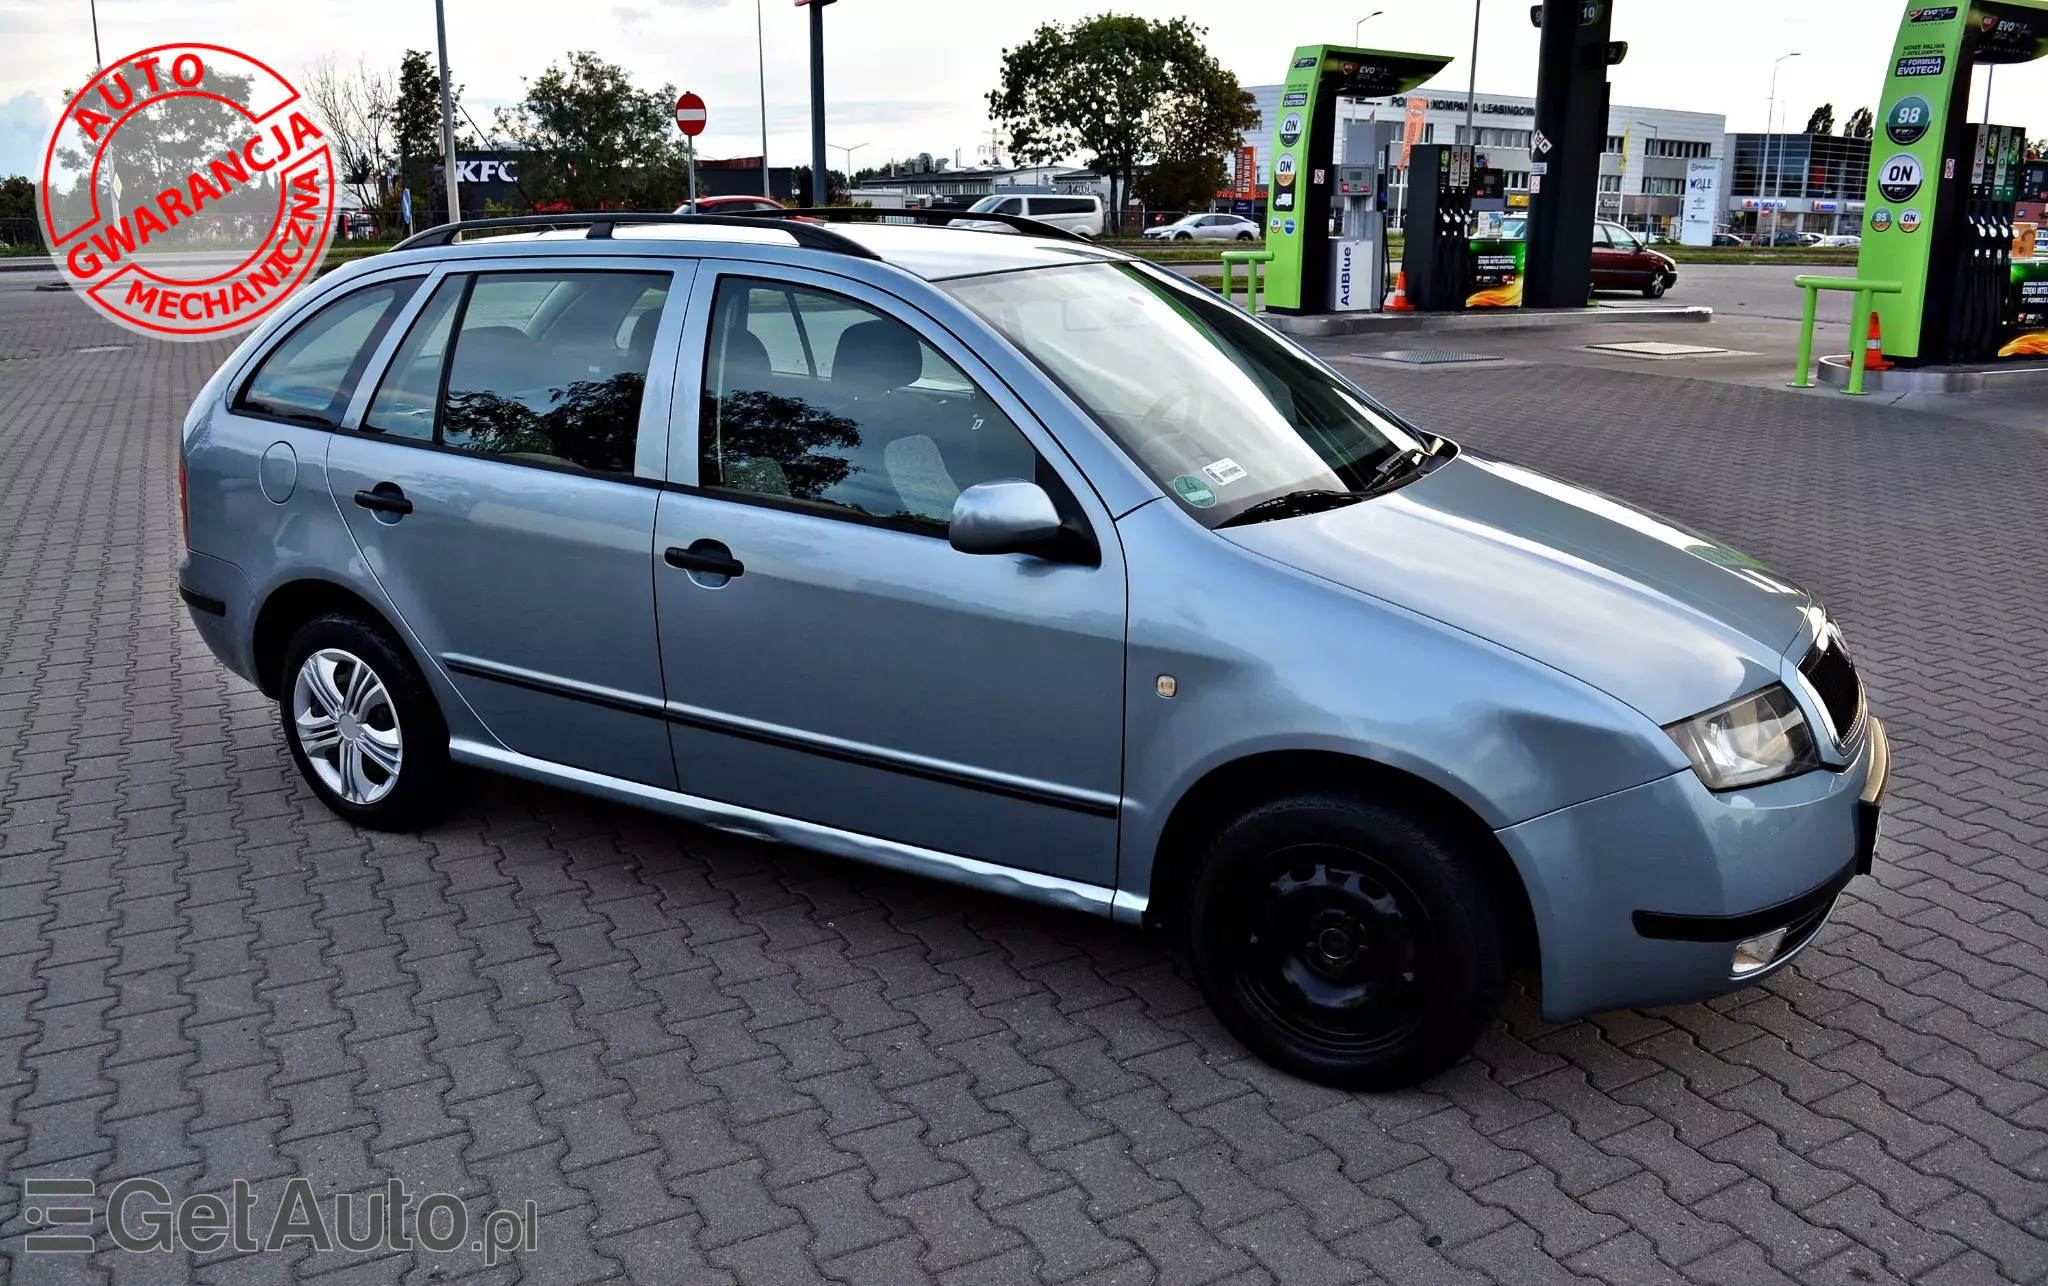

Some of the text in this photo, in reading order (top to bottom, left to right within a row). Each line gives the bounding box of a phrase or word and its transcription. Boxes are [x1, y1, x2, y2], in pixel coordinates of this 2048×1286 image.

[1582, 6, 1596, 19] 10
[1997, 20, 2015, 32] EVO
[1608, 47, 1616, 59] 2
[1359, 65, 1376, 74] EVO
[1896, 65, 1941, 76] EVOTECH
[1482, 102, 1536, 117] LEASINGOW
[1897, 106, 1921, 124] 98
[1284, 119, 1298, 132] ON
[456, 160, 518, 182] KFC
[1279, 160, 1292, 172] ON
[1888, 165, 1914, 182] ON
[1875, 212, 1888, 222] 95
[1903, 213, 1916, 223] ON
[1340, 246, 1351, 307] AdBlue
